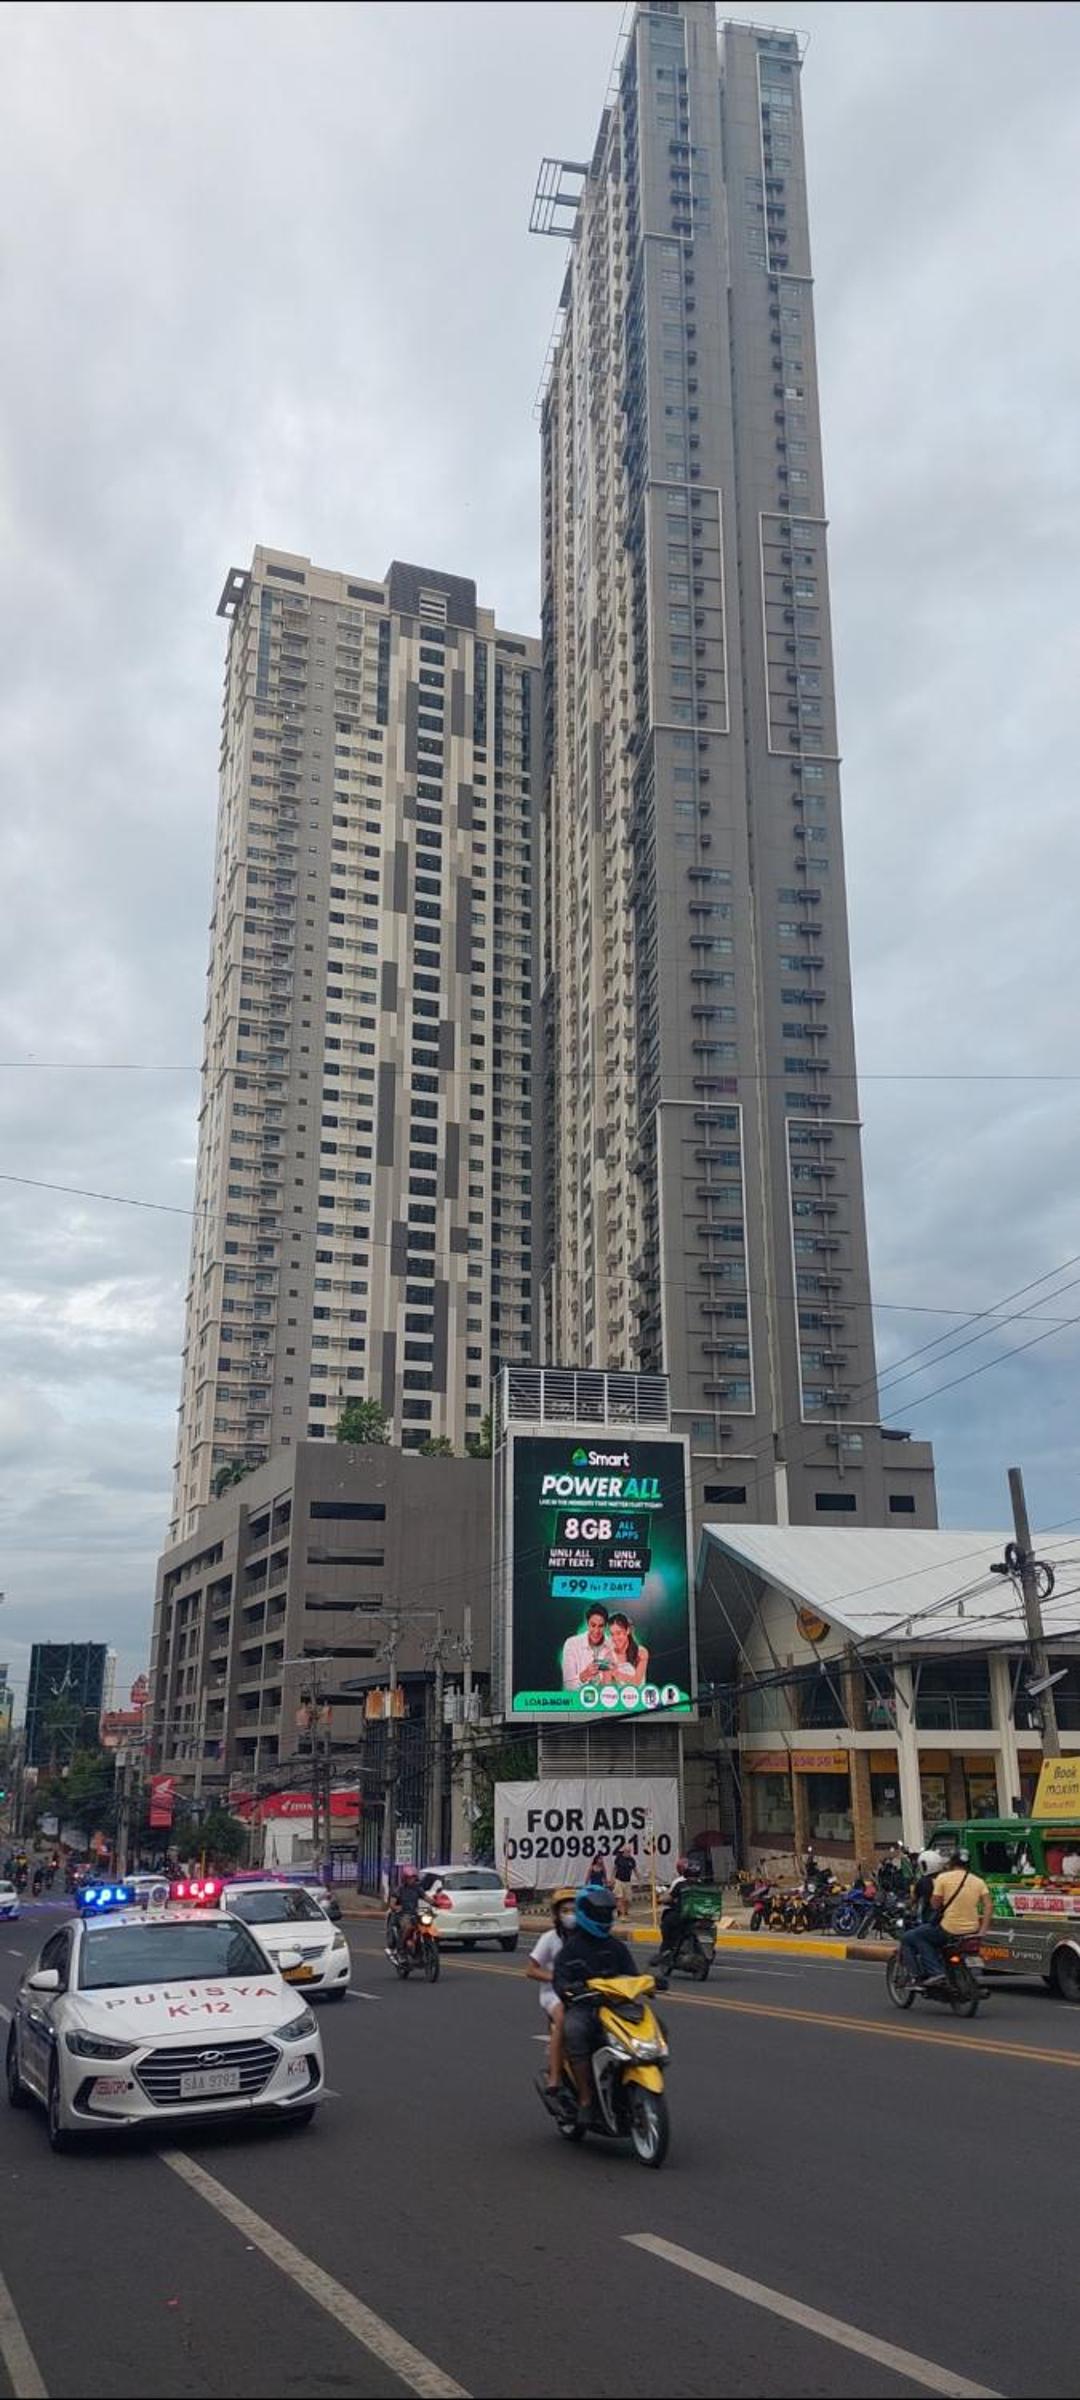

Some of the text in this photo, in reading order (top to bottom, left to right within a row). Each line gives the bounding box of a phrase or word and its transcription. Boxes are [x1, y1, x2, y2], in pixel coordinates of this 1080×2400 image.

[588, 1451, 630, 1467] Smart
[564, 1518, 612, 1540] 8GB
[619, 1521, 635, 1530] ALL
[615, 1531, 640, 1539] APPS
[550, 1548, 591, 1557] UNLI ALL
[614, 1550, 637, 1559] UNLI
[548, 1558, 595, 1568] NET TEXTS
[608, 1560, 642, 1569] TIKTOK
[611, 1582, 633, 1591] DAYS
[527, 1807, 646, 1832] FOR ADS
[105, 1986, 278, 2010] PULISYA
[167, 2002, 232, 2018] K-12
